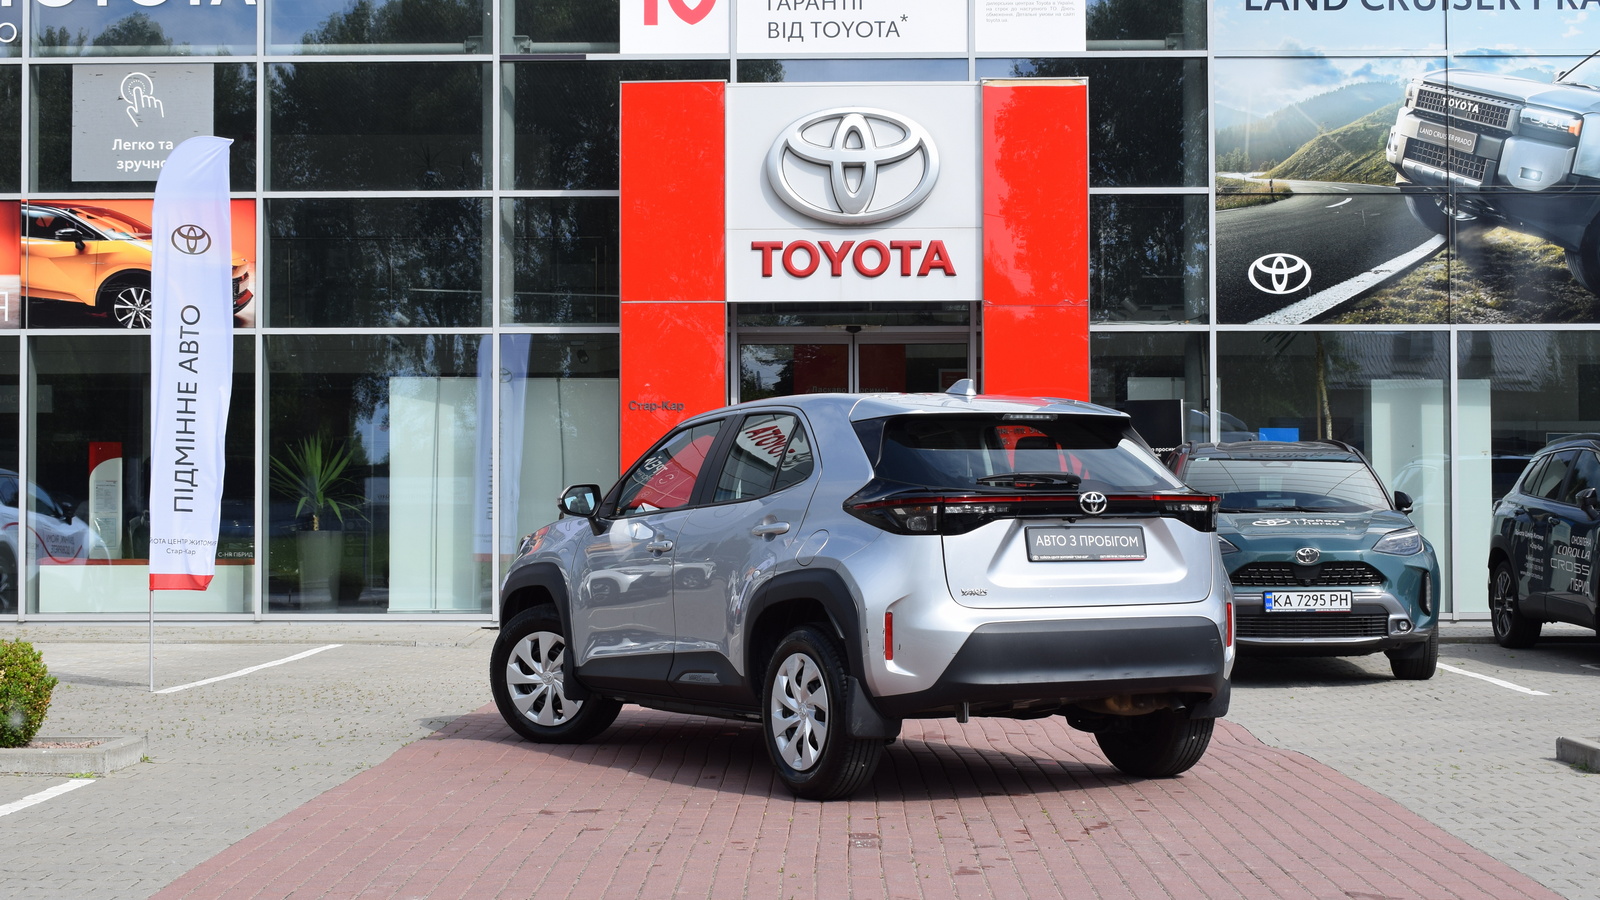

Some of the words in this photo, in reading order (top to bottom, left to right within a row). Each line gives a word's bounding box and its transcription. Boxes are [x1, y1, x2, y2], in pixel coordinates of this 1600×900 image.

[768, 21, 804, 42] ВІД
[1442, 97, 1479, 114] TOYOTA
[112, 138, 155, 150] Легко
[158, 141, 174, 150] та
[1419, 127, 1433, 136] LAND
[1454, 135, 1472, 146] PRADO
[751, 239, 957, 279] TOYOTA
[178, 304, 200, 374] АВТО
[628, 400, 684, 412] Стар-Кар
[174, 382, 199, 512] ПІДМІННЕ
[1036, 535, 1067, 546] АВТО
[1070, 536, 1077, 546] З
[1080, 536, 1139, 547] ПРОБІГОМ
[1557, 544, 1590, 560] COROLLA
[1550, 558, 1590, 576] CROSS
[1273, 594, 1292, 606] KA
[1296, 594, 1326, 606] 7295
[1330, 594, 1348, 606] PH
